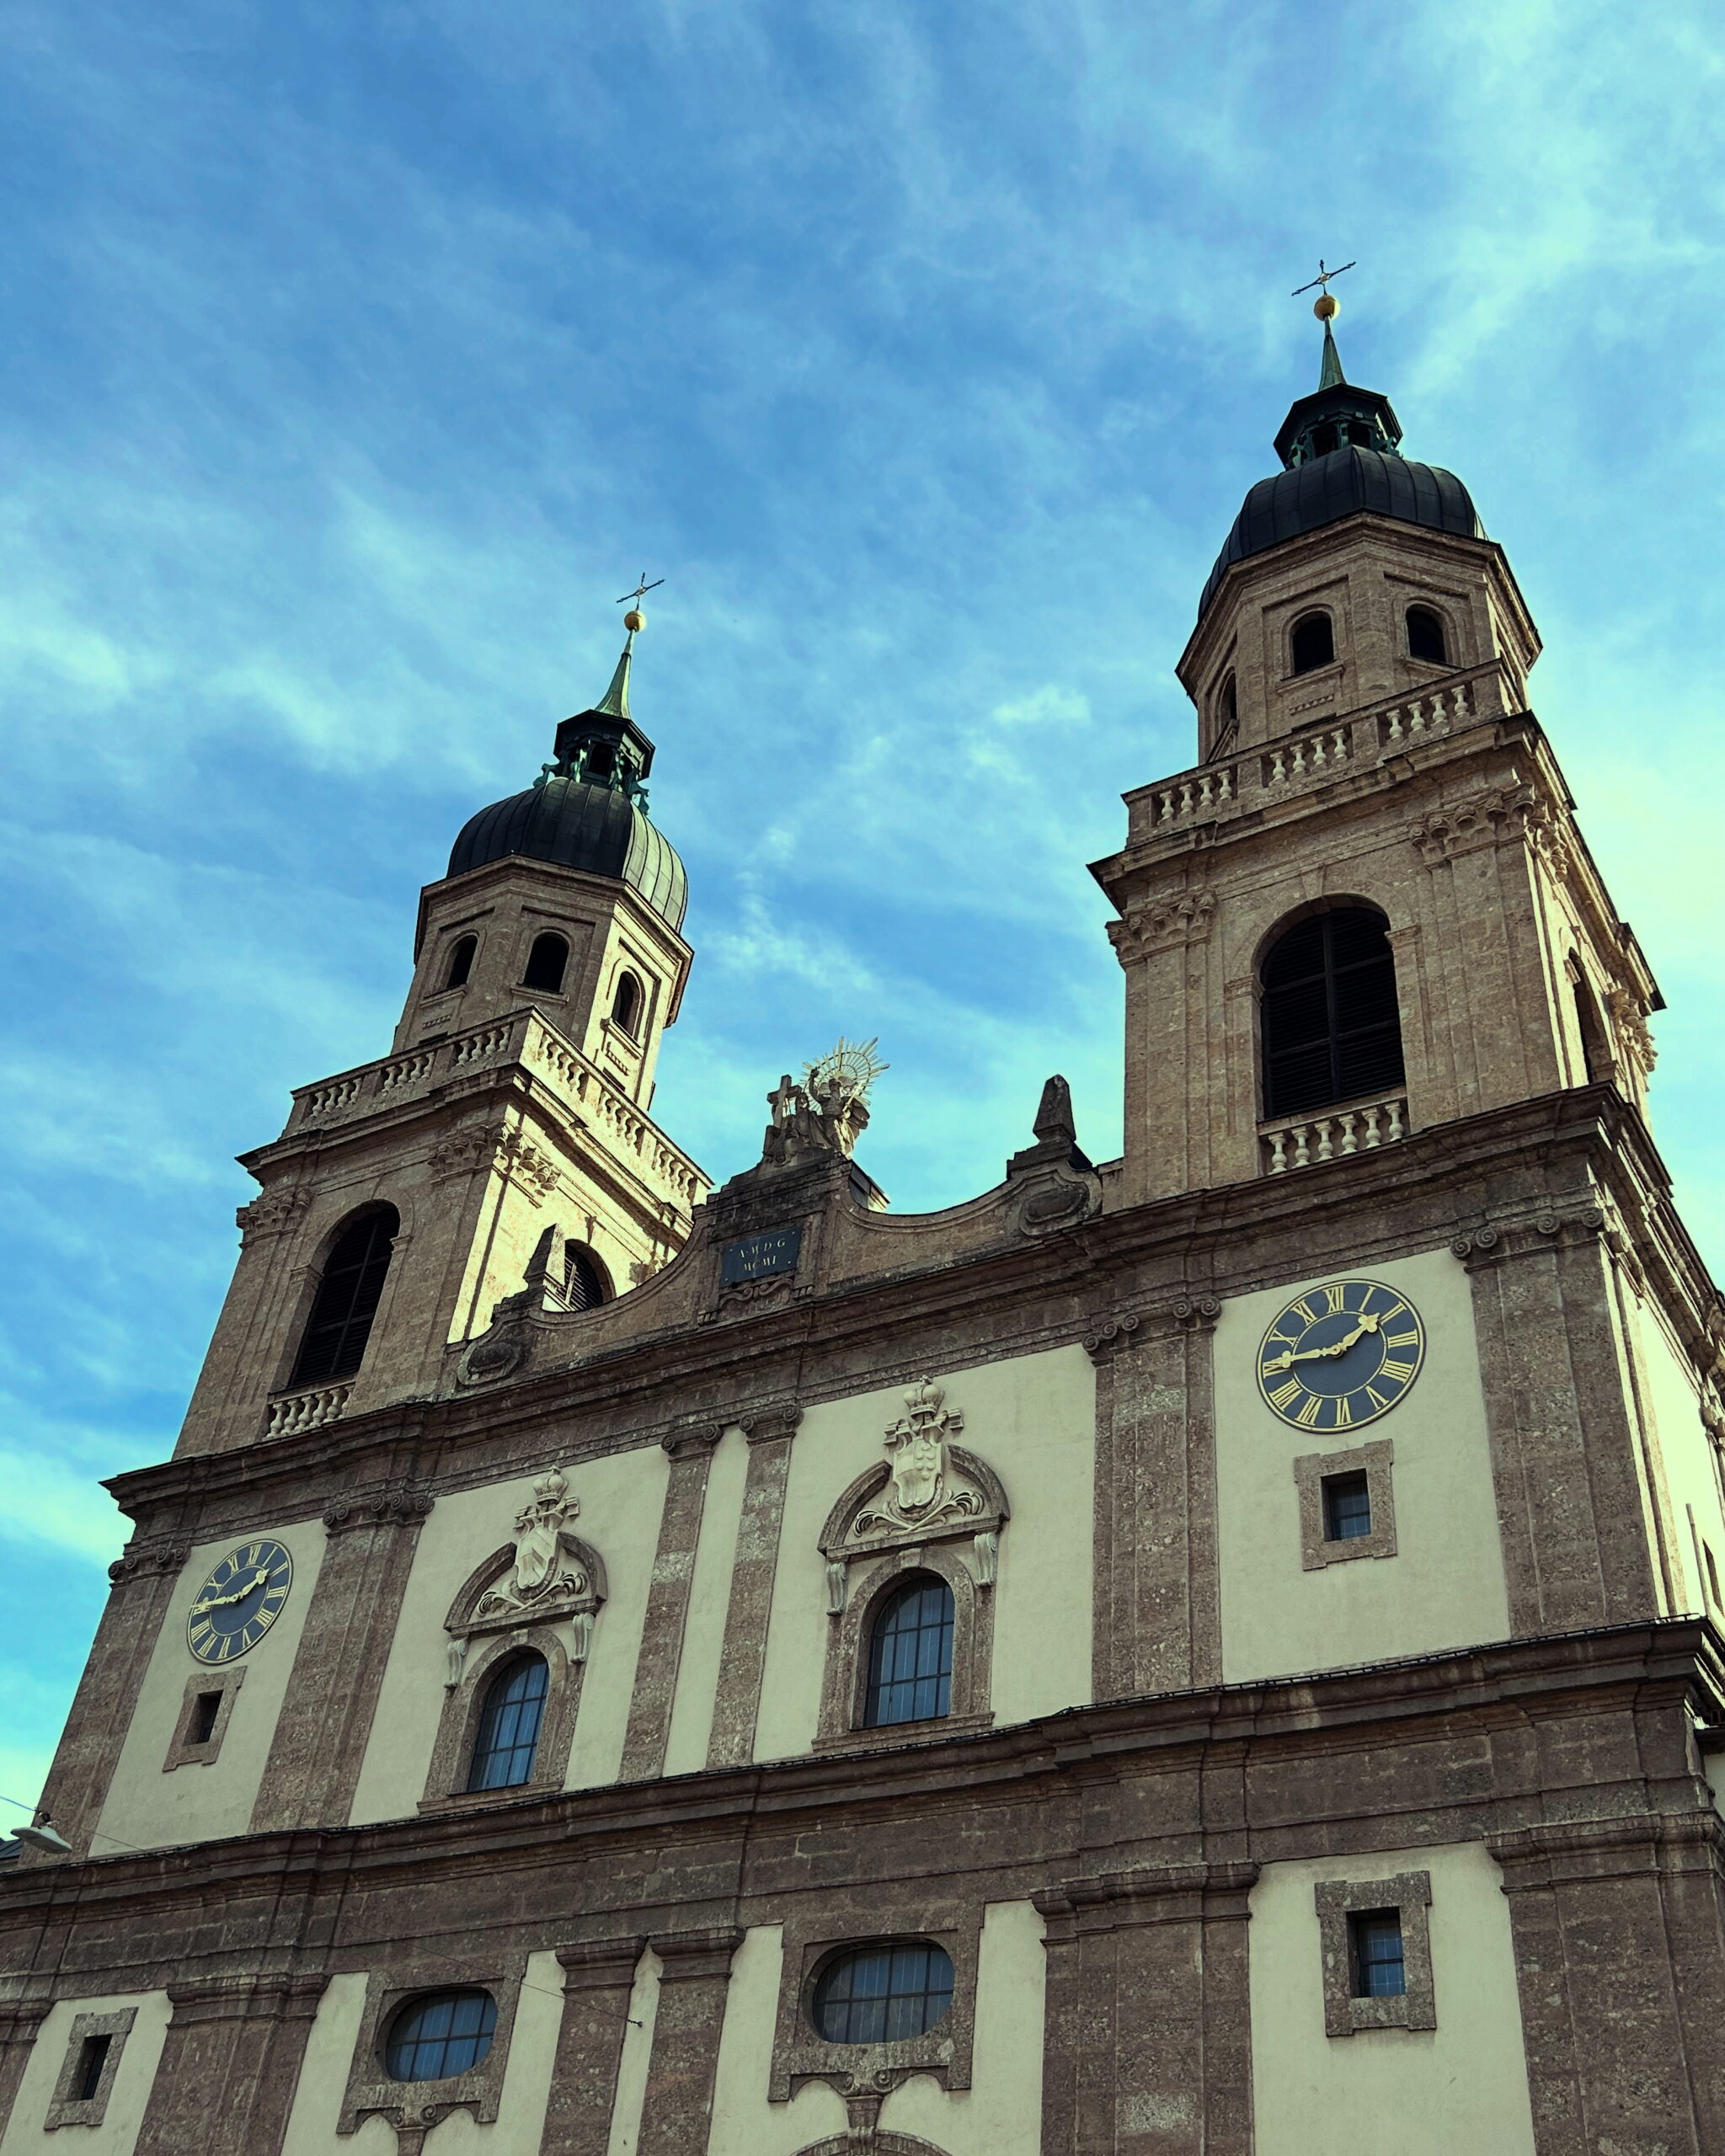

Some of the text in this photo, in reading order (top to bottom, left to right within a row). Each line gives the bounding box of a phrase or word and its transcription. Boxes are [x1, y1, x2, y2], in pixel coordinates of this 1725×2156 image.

[1323, 1286, 1346, 1313] XII
[1359, 1287, 1375, 1311] I
[1291, 1300, 1317, 1326] XI
[1379, 1302, 1407, 1325] II
[1268, 1328, 1297, 1347] X
[1388, 1330, 1418, 1348] III
[1380, 1358, 1414, 1383] IIII
[1268, 1380, 1302, 1411] VIII
[1365, 1385, 1388, 1410] V
[1295, 1396, 1322, 1425] VII
[1335, 1398, 1352, 1426] VI
[227, 1554, 238, 1575] XI
[247, 1545, 262, 1565] XII
[263, 1546, 277, 1566] I
[270, 1561, 288, 1577] II
[207, 1577, 222, 1592] X
[267, 1585, 286, 1598] III
[255, 1609, 275, 1627] IIII
[192, 1619, 210, 1643] VIII
[243, 1629, 250, 1648] V
[198, 1633, 217, 1656] VII
[217, 1636, 230, 1659] VI
